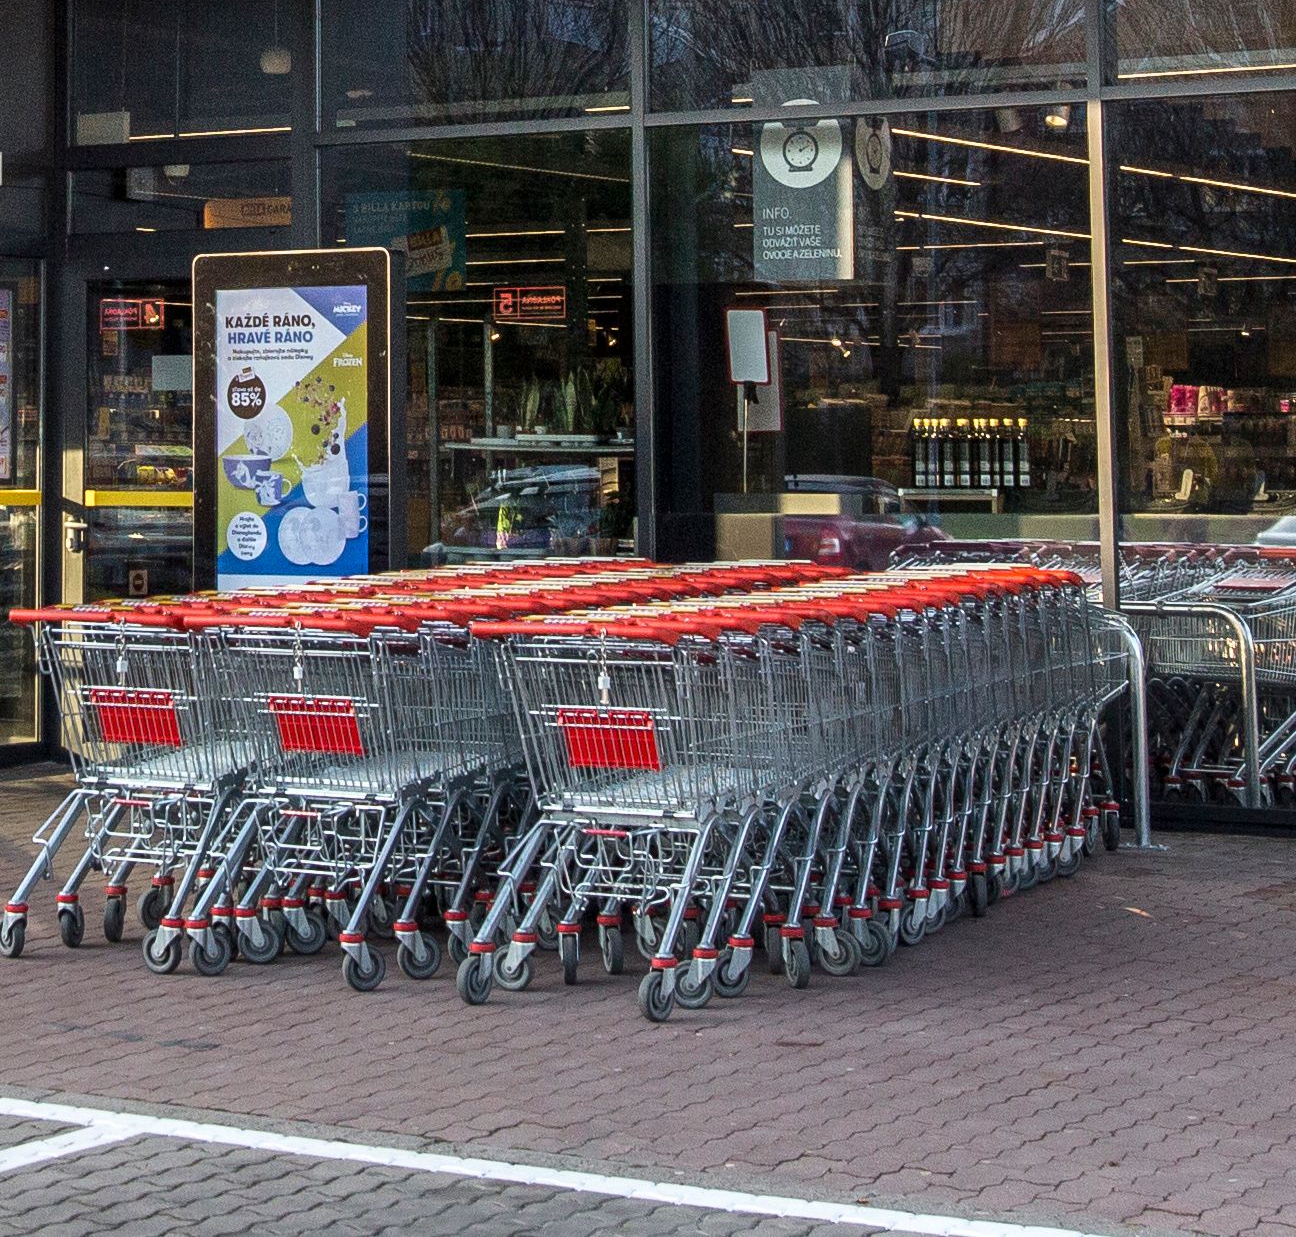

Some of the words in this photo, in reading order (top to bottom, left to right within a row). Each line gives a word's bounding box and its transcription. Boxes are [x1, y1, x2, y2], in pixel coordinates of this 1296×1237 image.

[762, 207, 792, 220] INFO.
[763, 226, 774, 236] TU
[776, 226, 784, 235] SI
[226, 313, 269, 328] KAŽDÉ
[273, 312, 316, 329] RÁNO,
[228, 330, 271, 344] HRAVÉ
[274, 328, 314, 343] RÁNO
[333, 357, 362, 367] FROZEN
[232, 392, 262, 407] 85%
